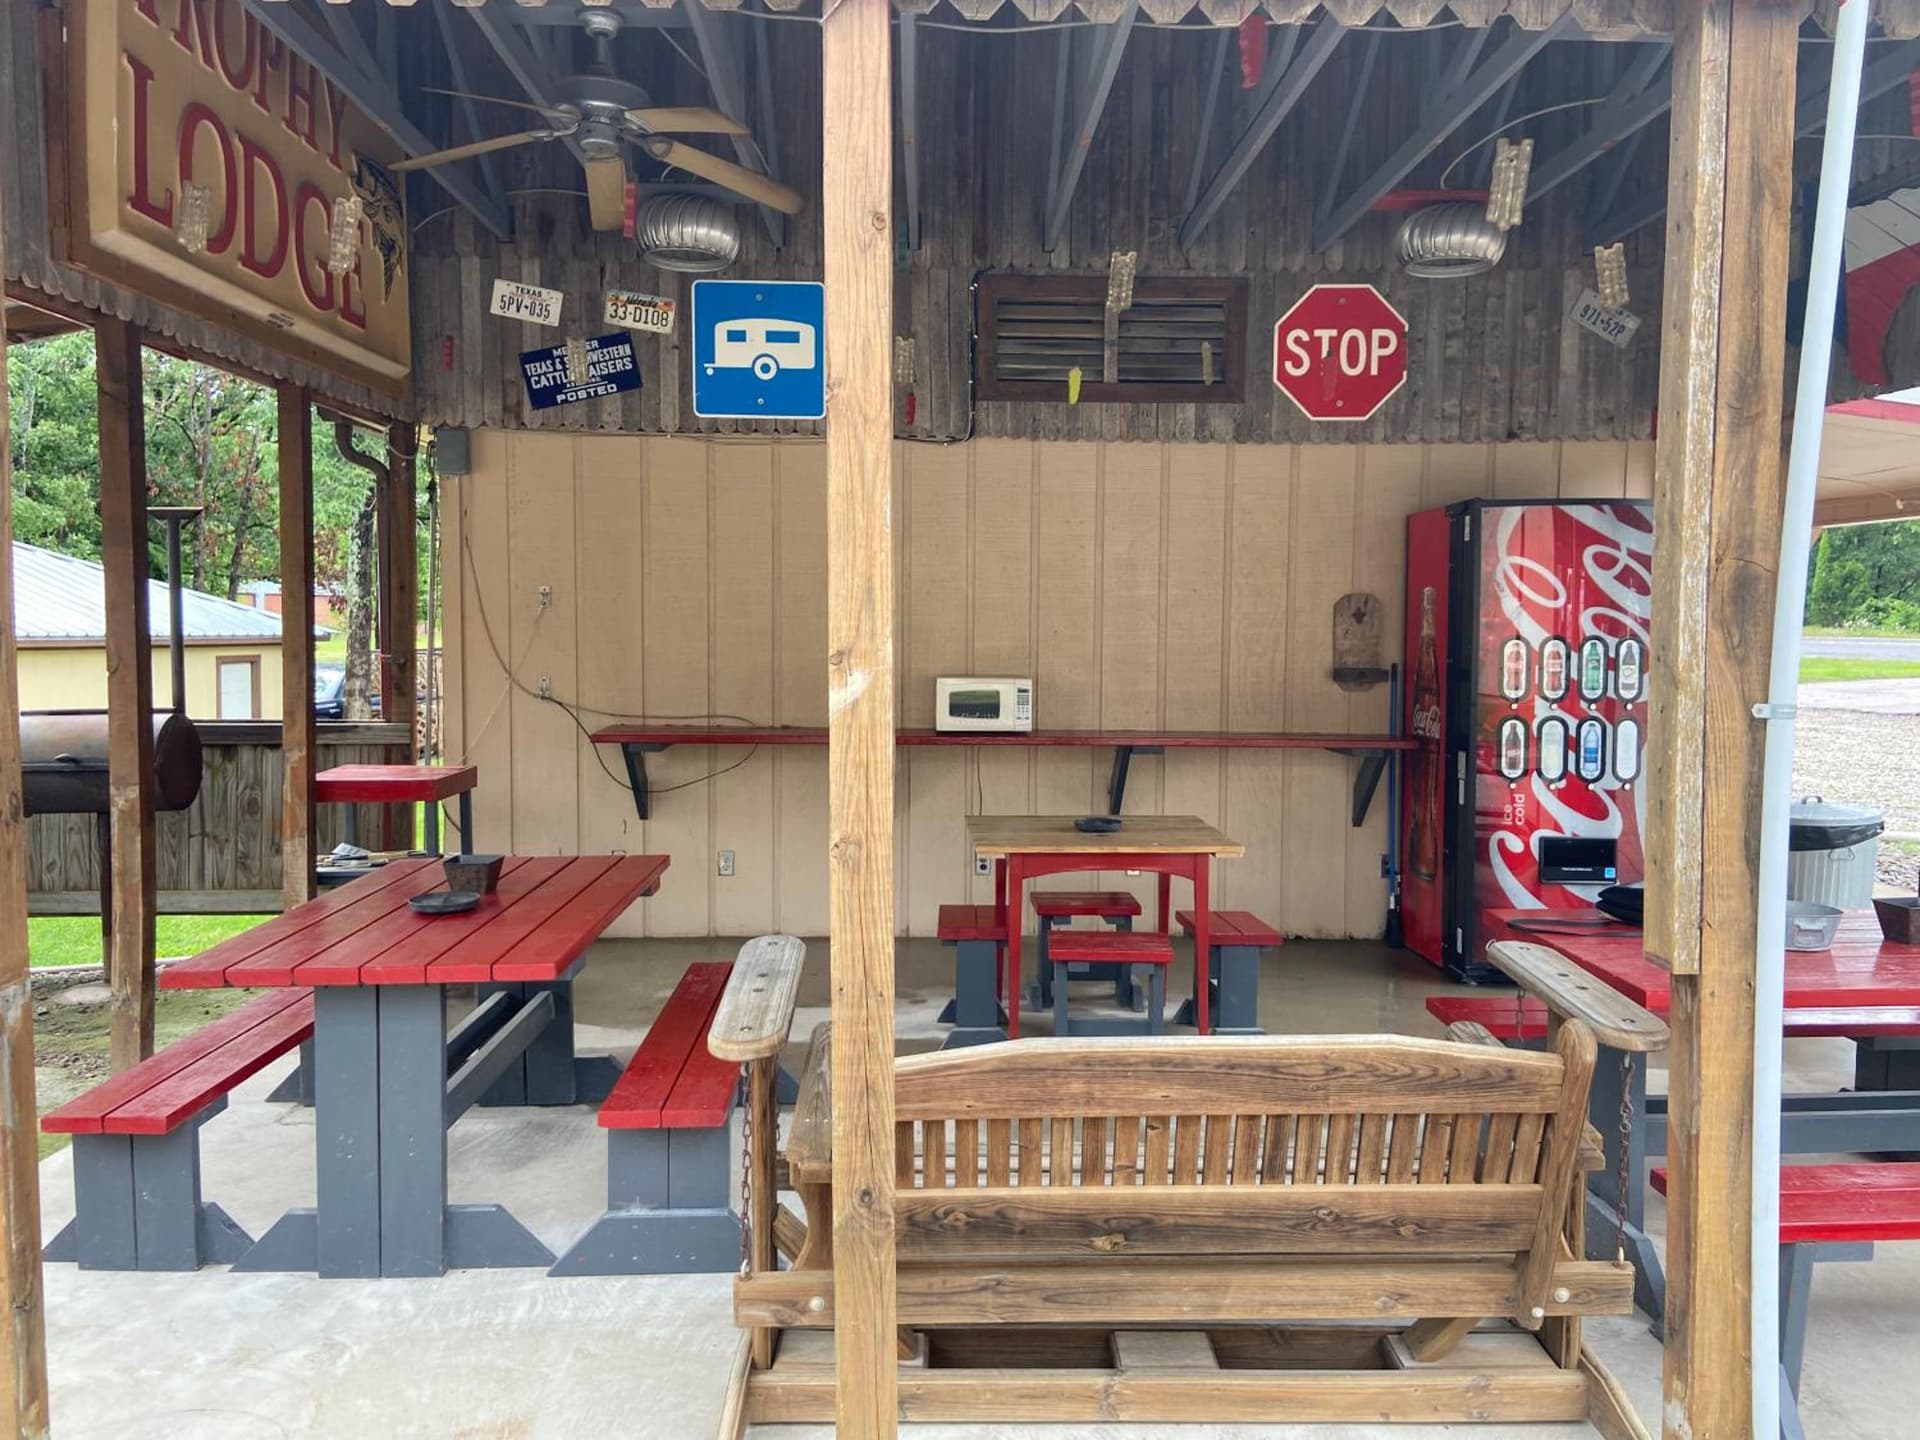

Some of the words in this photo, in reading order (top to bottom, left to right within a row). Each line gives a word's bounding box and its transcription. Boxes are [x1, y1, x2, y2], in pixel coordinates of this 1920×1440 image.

[135, 0, 346, 172] OPHY
[124, 50, 367, 331] LODGE
[515, 286, 543, 298] TEXAS
[524, 359, 554, 377] TEXAS
[555, 358, 564, 371] &
[564, 344, 632, 370] SWESTERN
[553, 340, 600, 358] MEER
[1284, 328, 1398, 376] STOP
[530, 370, 569, 390] CATTL
[587, 357, 633, 378] AISERS
[556, 383, 618, 404] POSTED
[1501, 804, 1513, 826] ice
[1513, 793, 1526, 826] cold
